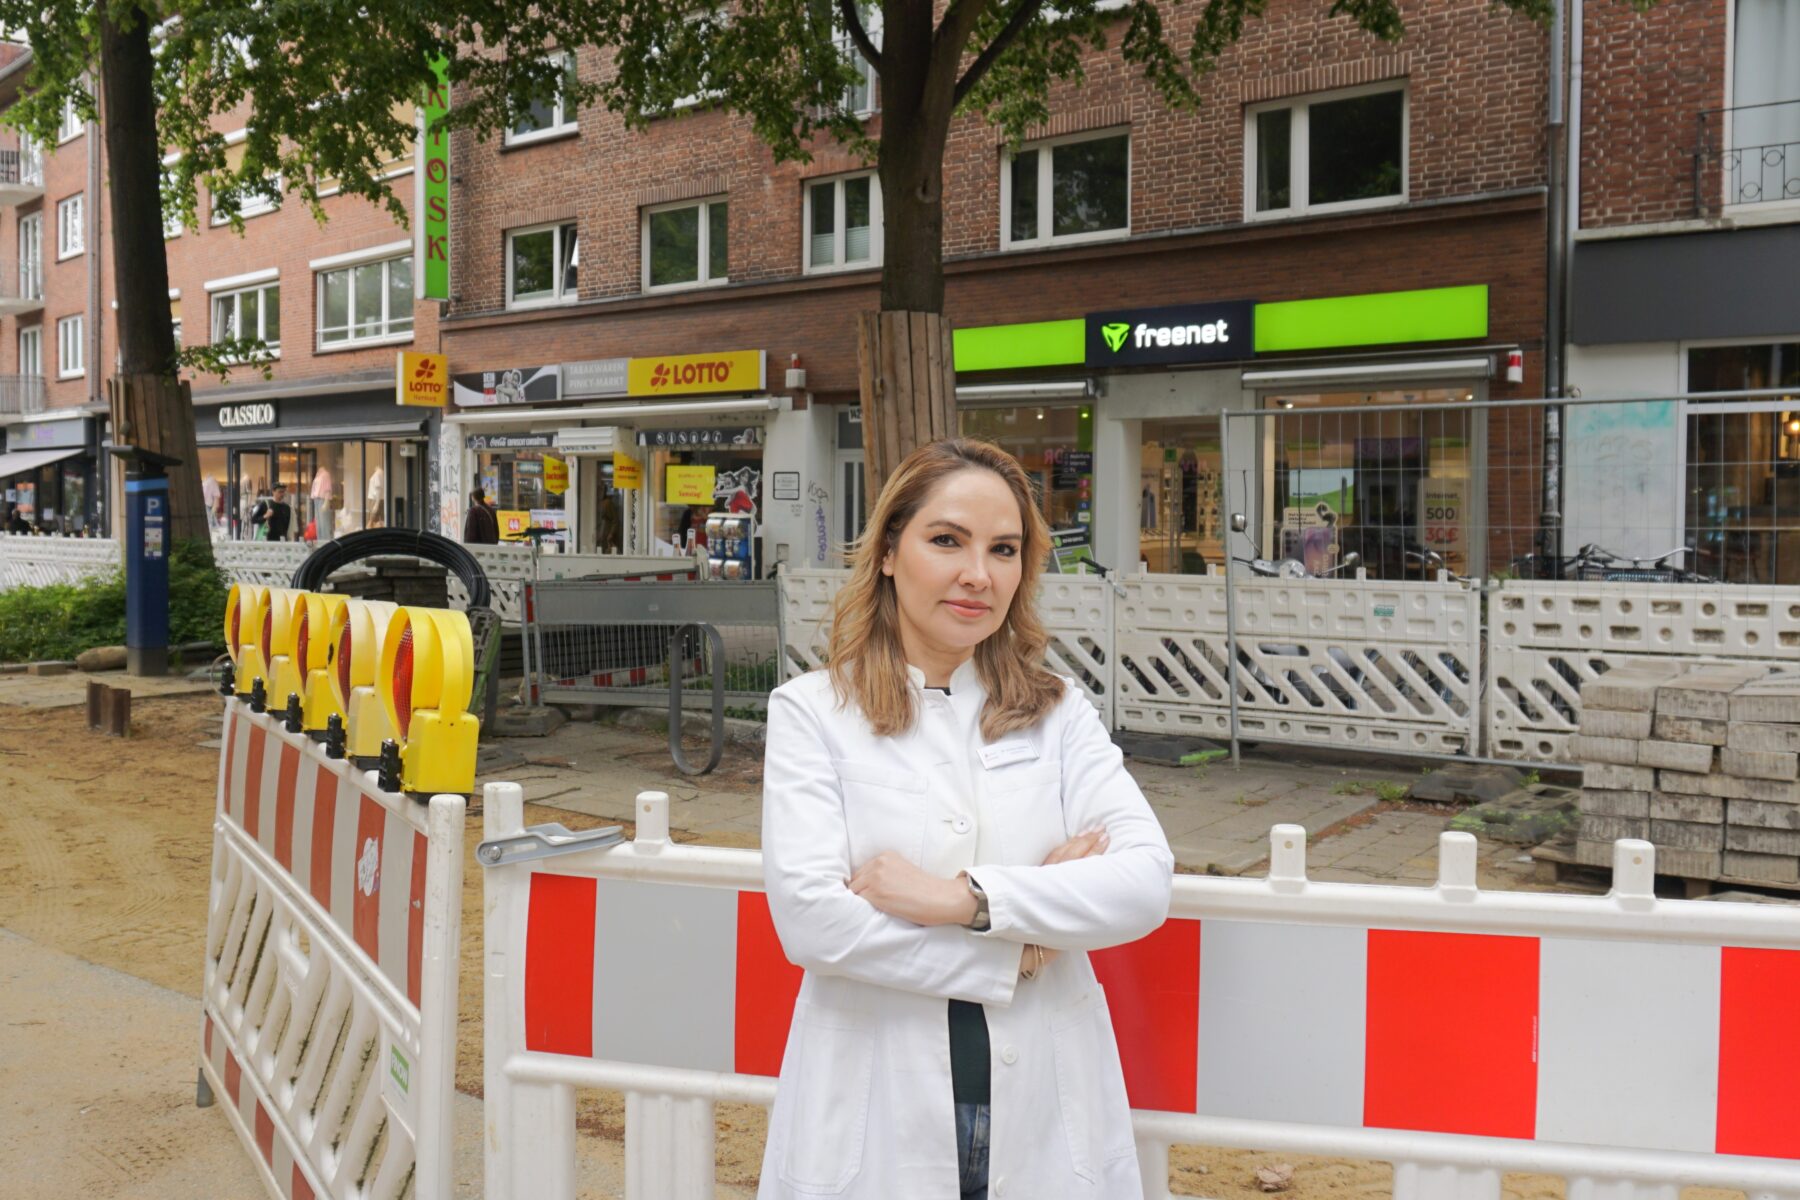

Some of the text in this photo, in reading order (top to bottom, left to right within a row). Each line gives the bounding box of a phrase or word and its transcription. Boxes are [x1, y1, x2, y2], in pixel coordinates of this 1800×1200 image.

[427, 84, 447, 261] KIOSK
[1134, 318, 1229, 349] freenet
[569, 362, 625, 376] TABAKWAREN
[673, 361, 730, 385] LOTTO
[409, 381, 442, 393] LOTTO
[568, 376, 625, 389] PINKY-MARKT
[219, 403, 275, 428] CLASSICO
[146, 497, 160, 515] P
[1426, 507, 1455, 520] 500
